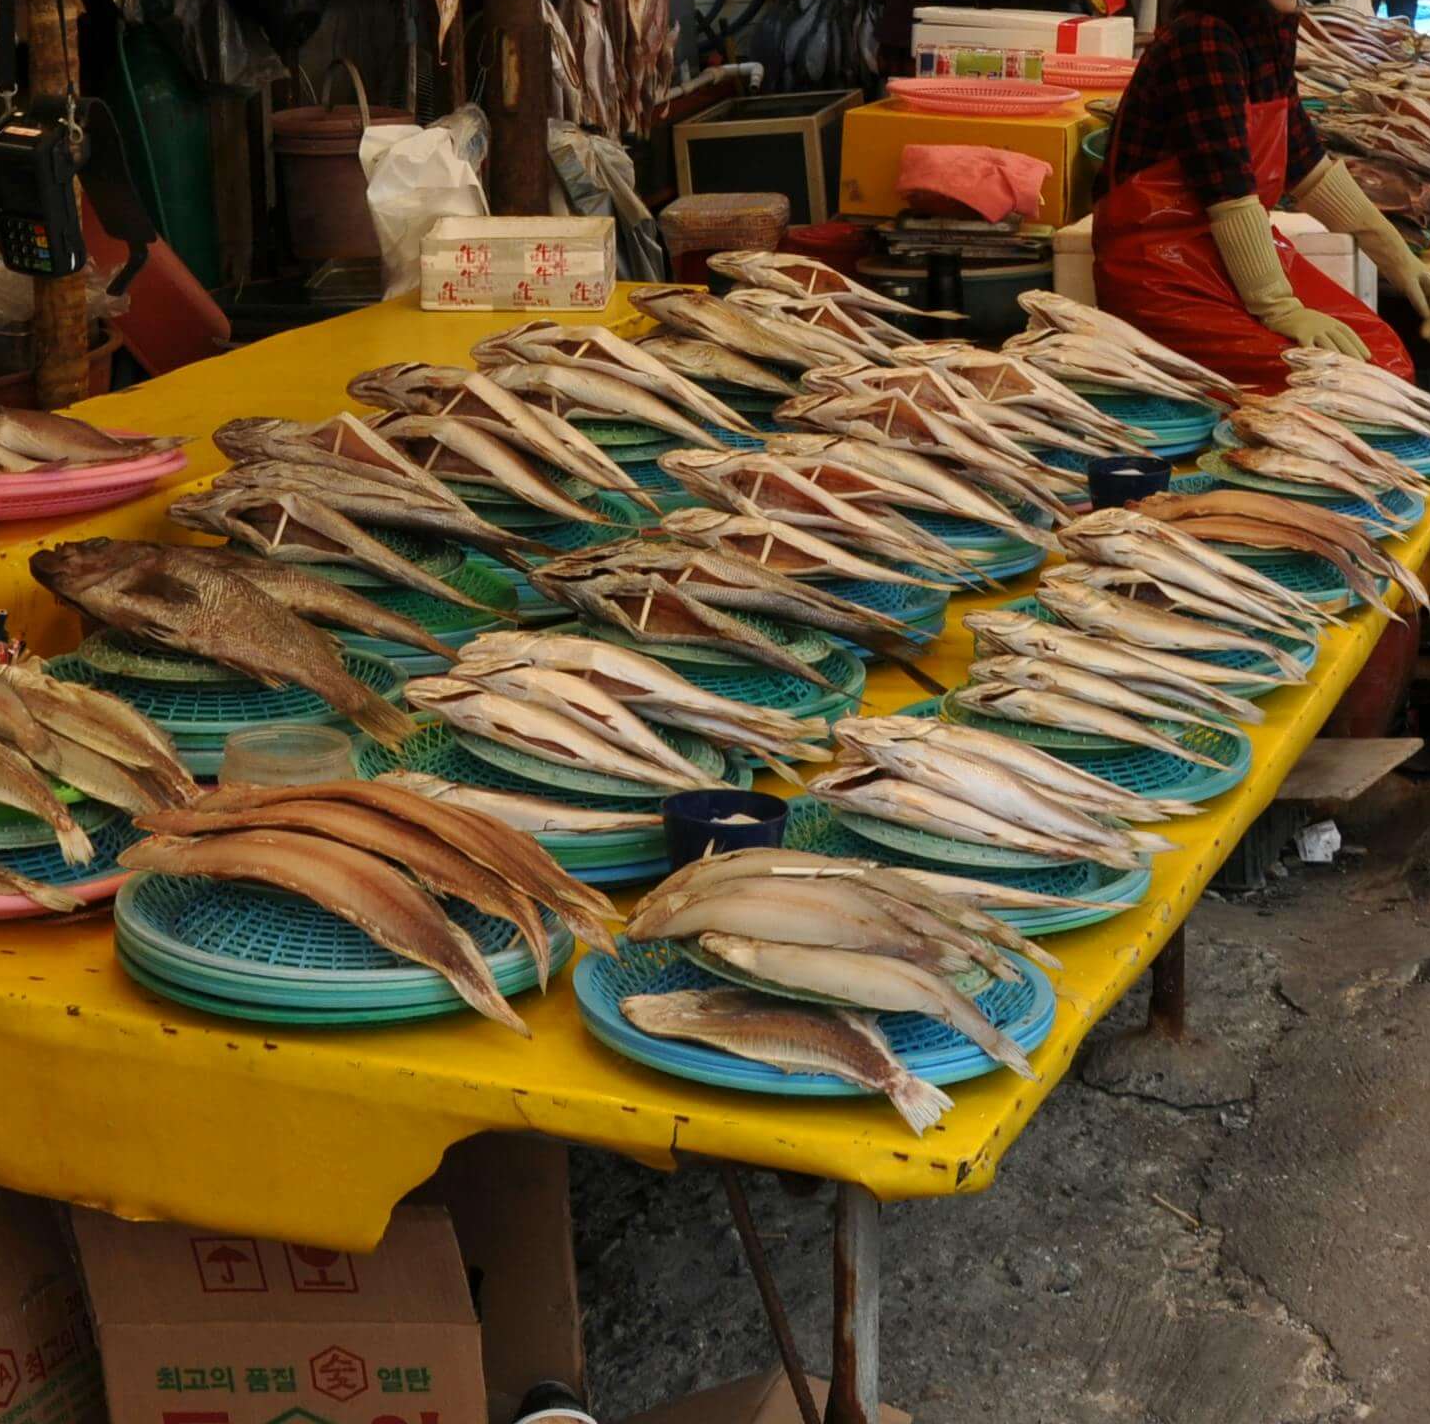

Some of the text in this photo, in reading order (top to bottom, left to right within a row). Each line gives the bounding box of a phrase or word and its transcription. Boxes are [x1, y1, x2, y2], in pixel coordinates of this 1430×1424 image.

[155, 1365, 235, 1393] 최고의
[244, 1365, 297, 1393] 품질
[376, 1365, 432, 1393] 열탄
